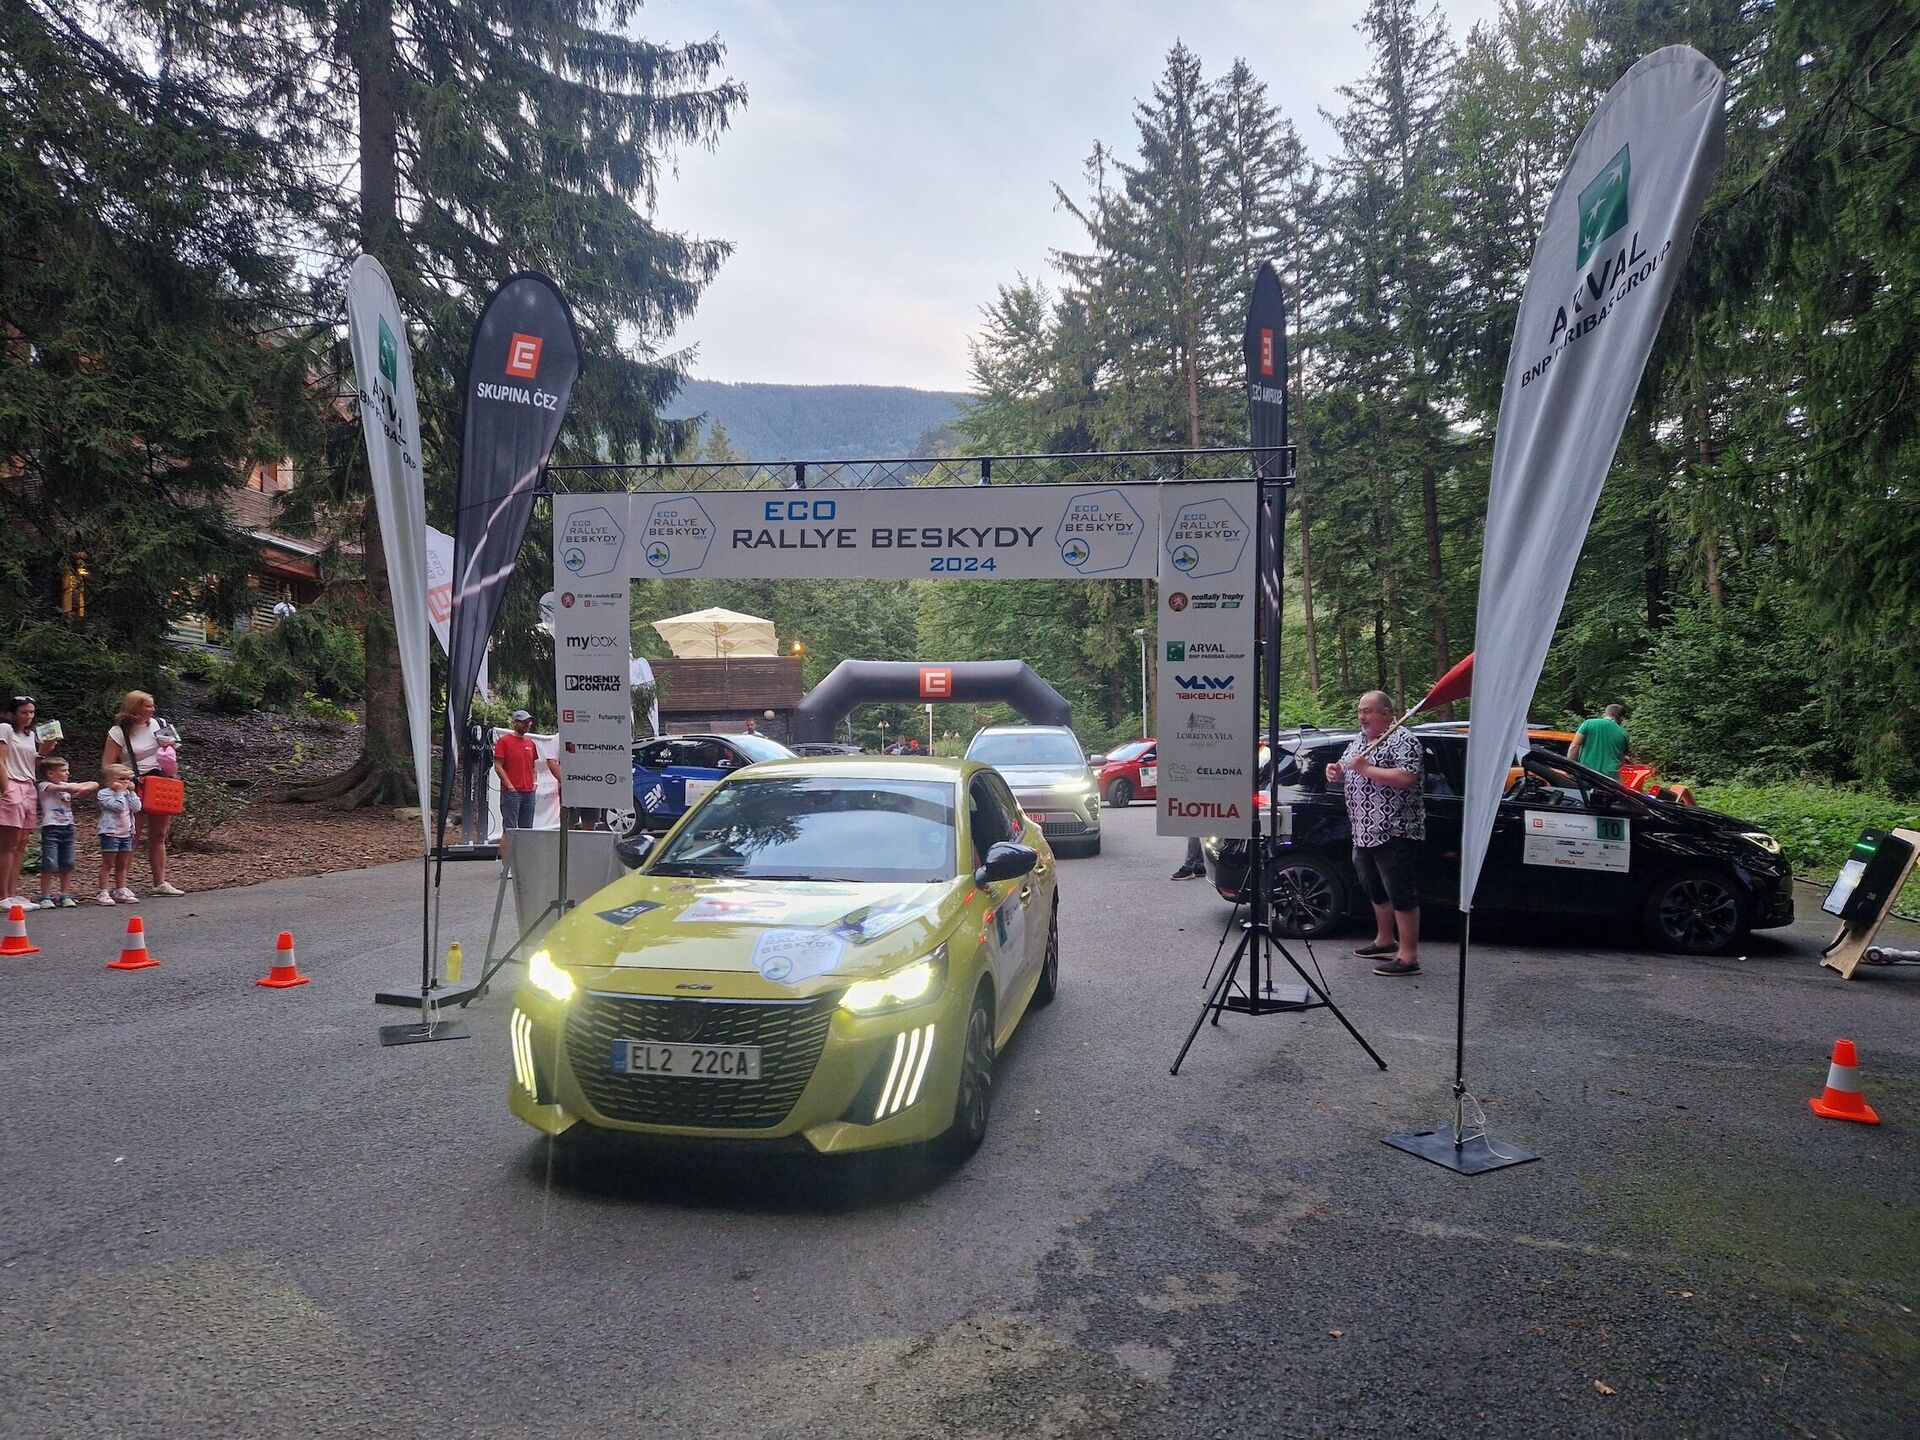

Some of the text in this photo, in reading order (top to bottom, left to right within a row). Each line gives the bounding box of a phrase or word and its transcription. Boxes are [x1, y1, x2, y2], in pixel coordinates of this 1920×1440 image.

[1520, 355, 1552, 388] BNP
[1617, 239, 1673, 302] GROUP
[477, 382, 558, 411] SKUPINA ČEZ
[765, 501, 836, 521] ECO
[1075, 505, 1099, 513] ECO
[1071, 512, 1123, 522] RALLYE
[1184, 513, 1207, 521] ECO
[653, 518, 698, 527] RALLYE
[1065, 523, 1134, 532] BESKYDY
[1180, 520, 1230, 530] RALLYE
[569, 527, 609, 535] RALLYE
[649, 528, 707, 536] BESKYDY
[1175, 530, 1241, 540] BESKYDY
[732, 527, 1043, 549] RALLYE BESKYDY
[930, 557, 997, 571] 2024
[1221, 593, 1244, 601] Trophy
[566, 633, 617, 649] mybox
[1189, 643, 1226, 653] ARVAL
[579, 683, 622, 691] CONTACT
[1176, 731, 1234, 740] LORKOVA VILA
[576, 743, 625, 751] TECHNIKA
[1168, 797, 1240, 818] FLOTILA
[1602, 821, 1621, 838] 10
[631, 1046, 749, 1076] EL2 22CA
